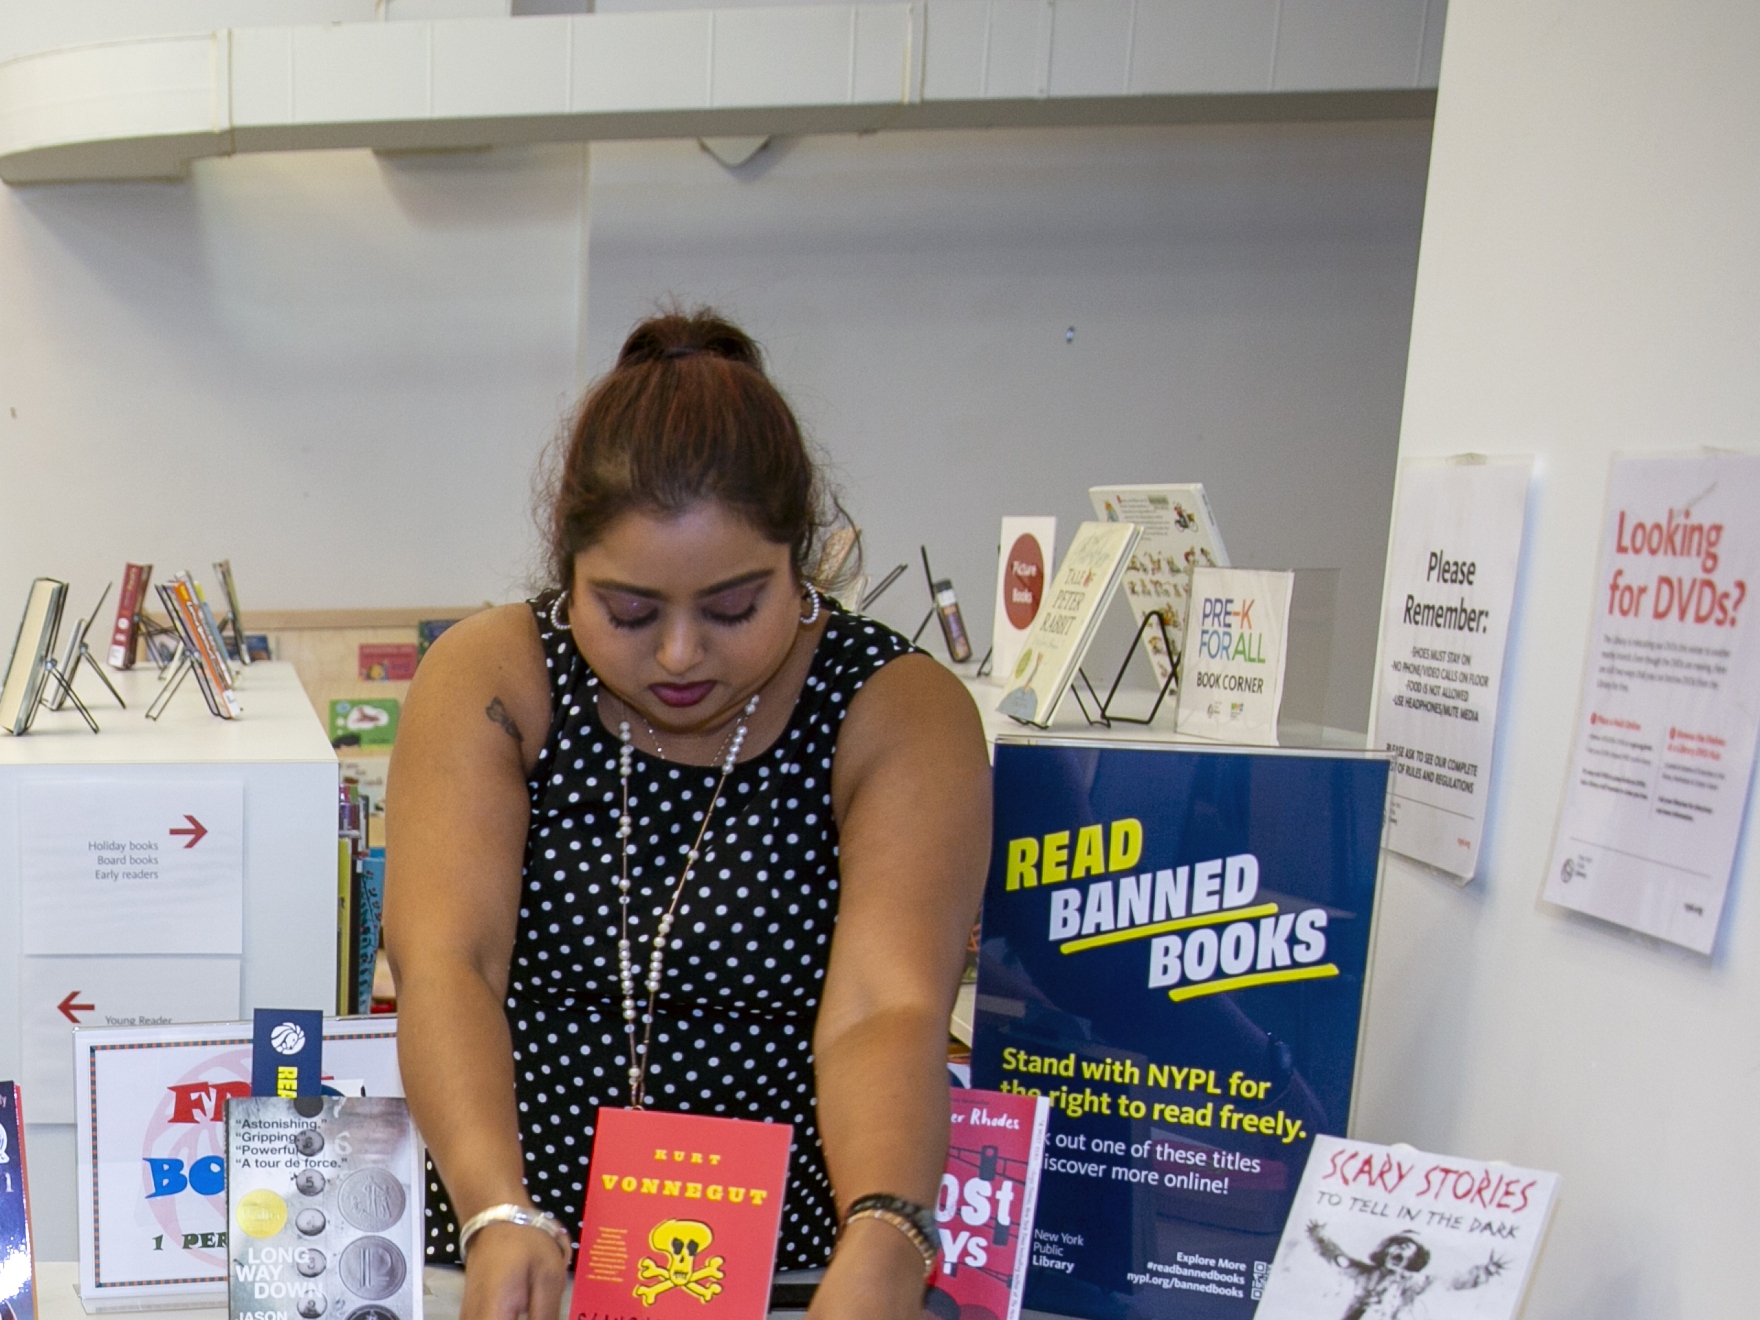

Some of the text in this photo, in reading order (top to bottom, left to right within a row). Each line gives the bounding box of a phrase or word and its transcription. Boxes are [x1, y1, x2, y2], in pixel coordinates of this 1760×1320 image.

[1615, 507, 1723, 575] Looking
[1011, 562, 1037, 575] Picture
[1426, 551, 1476, 586] Please
[1011, 588, 1032, 603] Books
[1052, 590, 1082, 611] PETER
[1608, 569, 1746, 628] for DVDs?
[1039, 613, 1076, 634] RABBIT
[1201, 597, 1256, 630] PRE-K
[1403, 594, 1489, 634] Remember:
[1198, 630, 1266, 664] FOR ALL
[1197, 671, 1264, 694] BOOK CORNER
[1448, 758, 1477, 777] COMPLETE
[1435, 773, 1474, 794] REGULATIONS
[88, 841, 158, 853] Holiday books
[1005, 817, 1143, 891] READ
[97, 855, 158, 865] Board books
[95, 869, 158, 882] Early readers
[1049, 853, 1259, 941] BANNED
[1148, 908, 1328, 989] BOOKS
[105, 1015, 172, 1025] Young Reader
[1002, 1048, 1271, 1101] Stand with NYPL for
[970, 1108, 1020, 1130] Rhodes
[1049, 1083, 1307, 1144] right to read freely.
[254, 1158, 301, 1169] tour de
[654, 1149, 722, 1166] KURT
[1056, 1133, 1086, 1151] out
[1091, 1137, 1126, 1155] one
[1131, 1134, 1152, 1158] of
[1156, 1142, 1208, 1166] these
[1212, 1148, 1261, 1174] titles
[1111, 1161, 1230, 1195] more online!
[1322, 1149, 1414, 1194] SCARY
[601, 1174, 768, 1206] VONNEGUT
[1417, 1165, 1538, 1215] STORIES
[1317, 1190, 1521, 1241] TO TELL IN THE DARK
[152, 1234, 163, 1251] 1
[1034, 1229, 1084, 1246] New York
[248, 1247, 310, 1264] LONG
[1033, 1242, 1064, 1257] Public
[1032, 1256, 1075, 1274] Library
[1176, 1251, 1247, 1271] Explore More
[235, 1264, 283, 1282] WAY
[1146, 1260, 1245, 1286] #readbannedbooks
[254, 1282, 323, 1299] DOWN
[1127, 1271, 1244, 1299] nypl.org/bannedbooks
